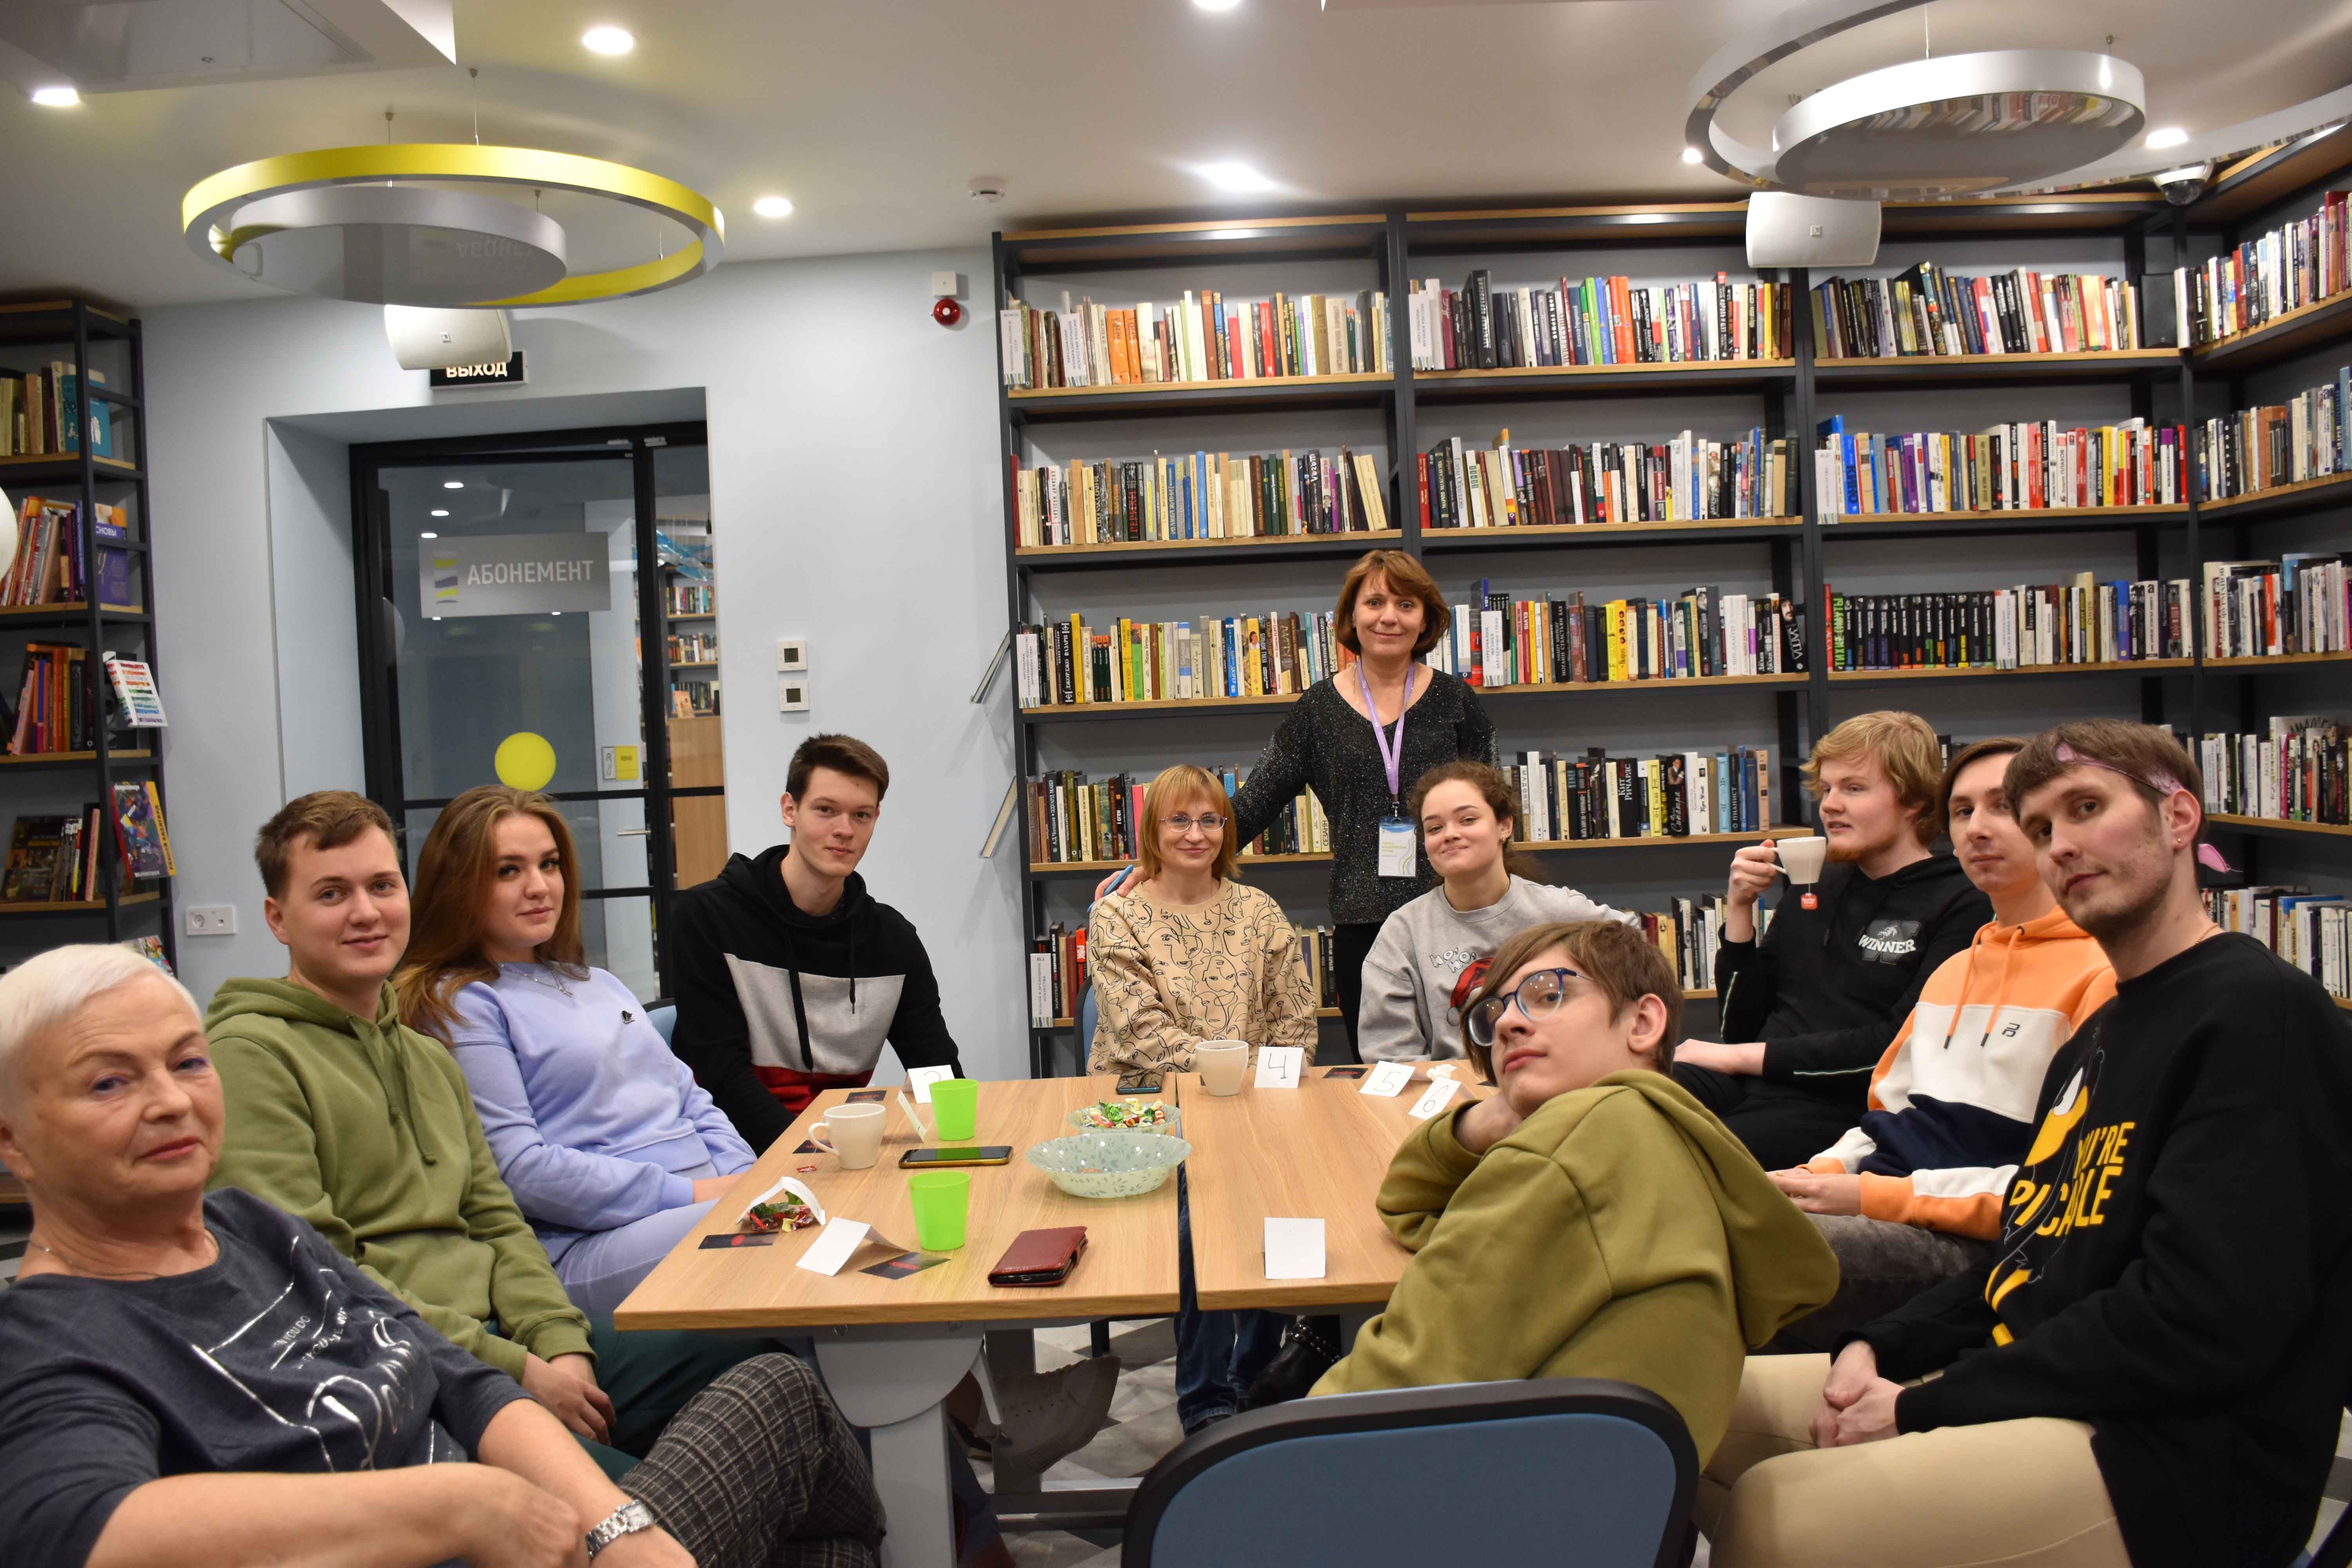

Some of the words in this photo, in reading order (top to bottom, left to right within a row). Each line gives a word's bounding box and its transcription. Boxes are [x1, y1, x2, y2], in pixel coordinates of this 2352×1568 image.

[446, 362, 508, 378] ВЫХОД
[96, 526, 117, 537] СНОВЫ
[467, 560, 594, 586] АБОНЕМЕНТ
[1077, 945, 1085, 960] РОК
[1858, 934, 1916, 954] WINNER
[1267, 1053, 1287, 1080] 4
[1373, 1072, 1402, 1092] 5
[1423, 1085, 1449, 1113] 6
